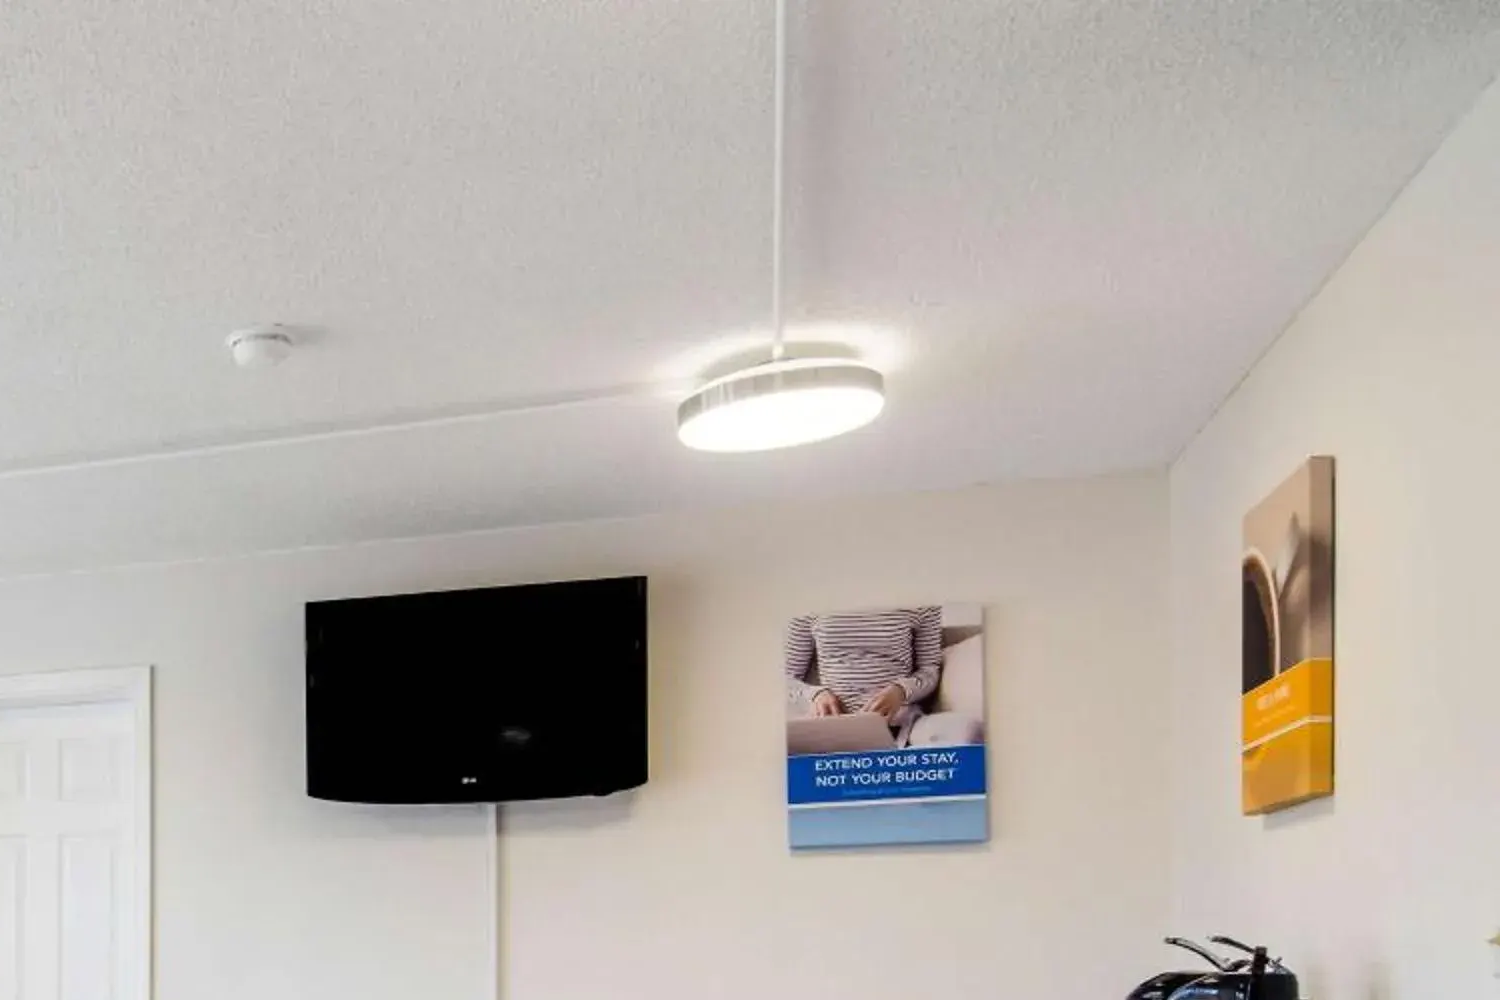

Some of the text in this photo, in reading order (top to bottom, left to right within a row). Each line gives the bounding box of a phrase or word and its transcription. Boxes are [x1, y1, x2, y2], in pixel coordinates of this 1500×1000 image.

[815, 751, 959, 771] EXTEND YOUR STAY,
[815, 767, 956, 787] NOT YOUR BUDGET
